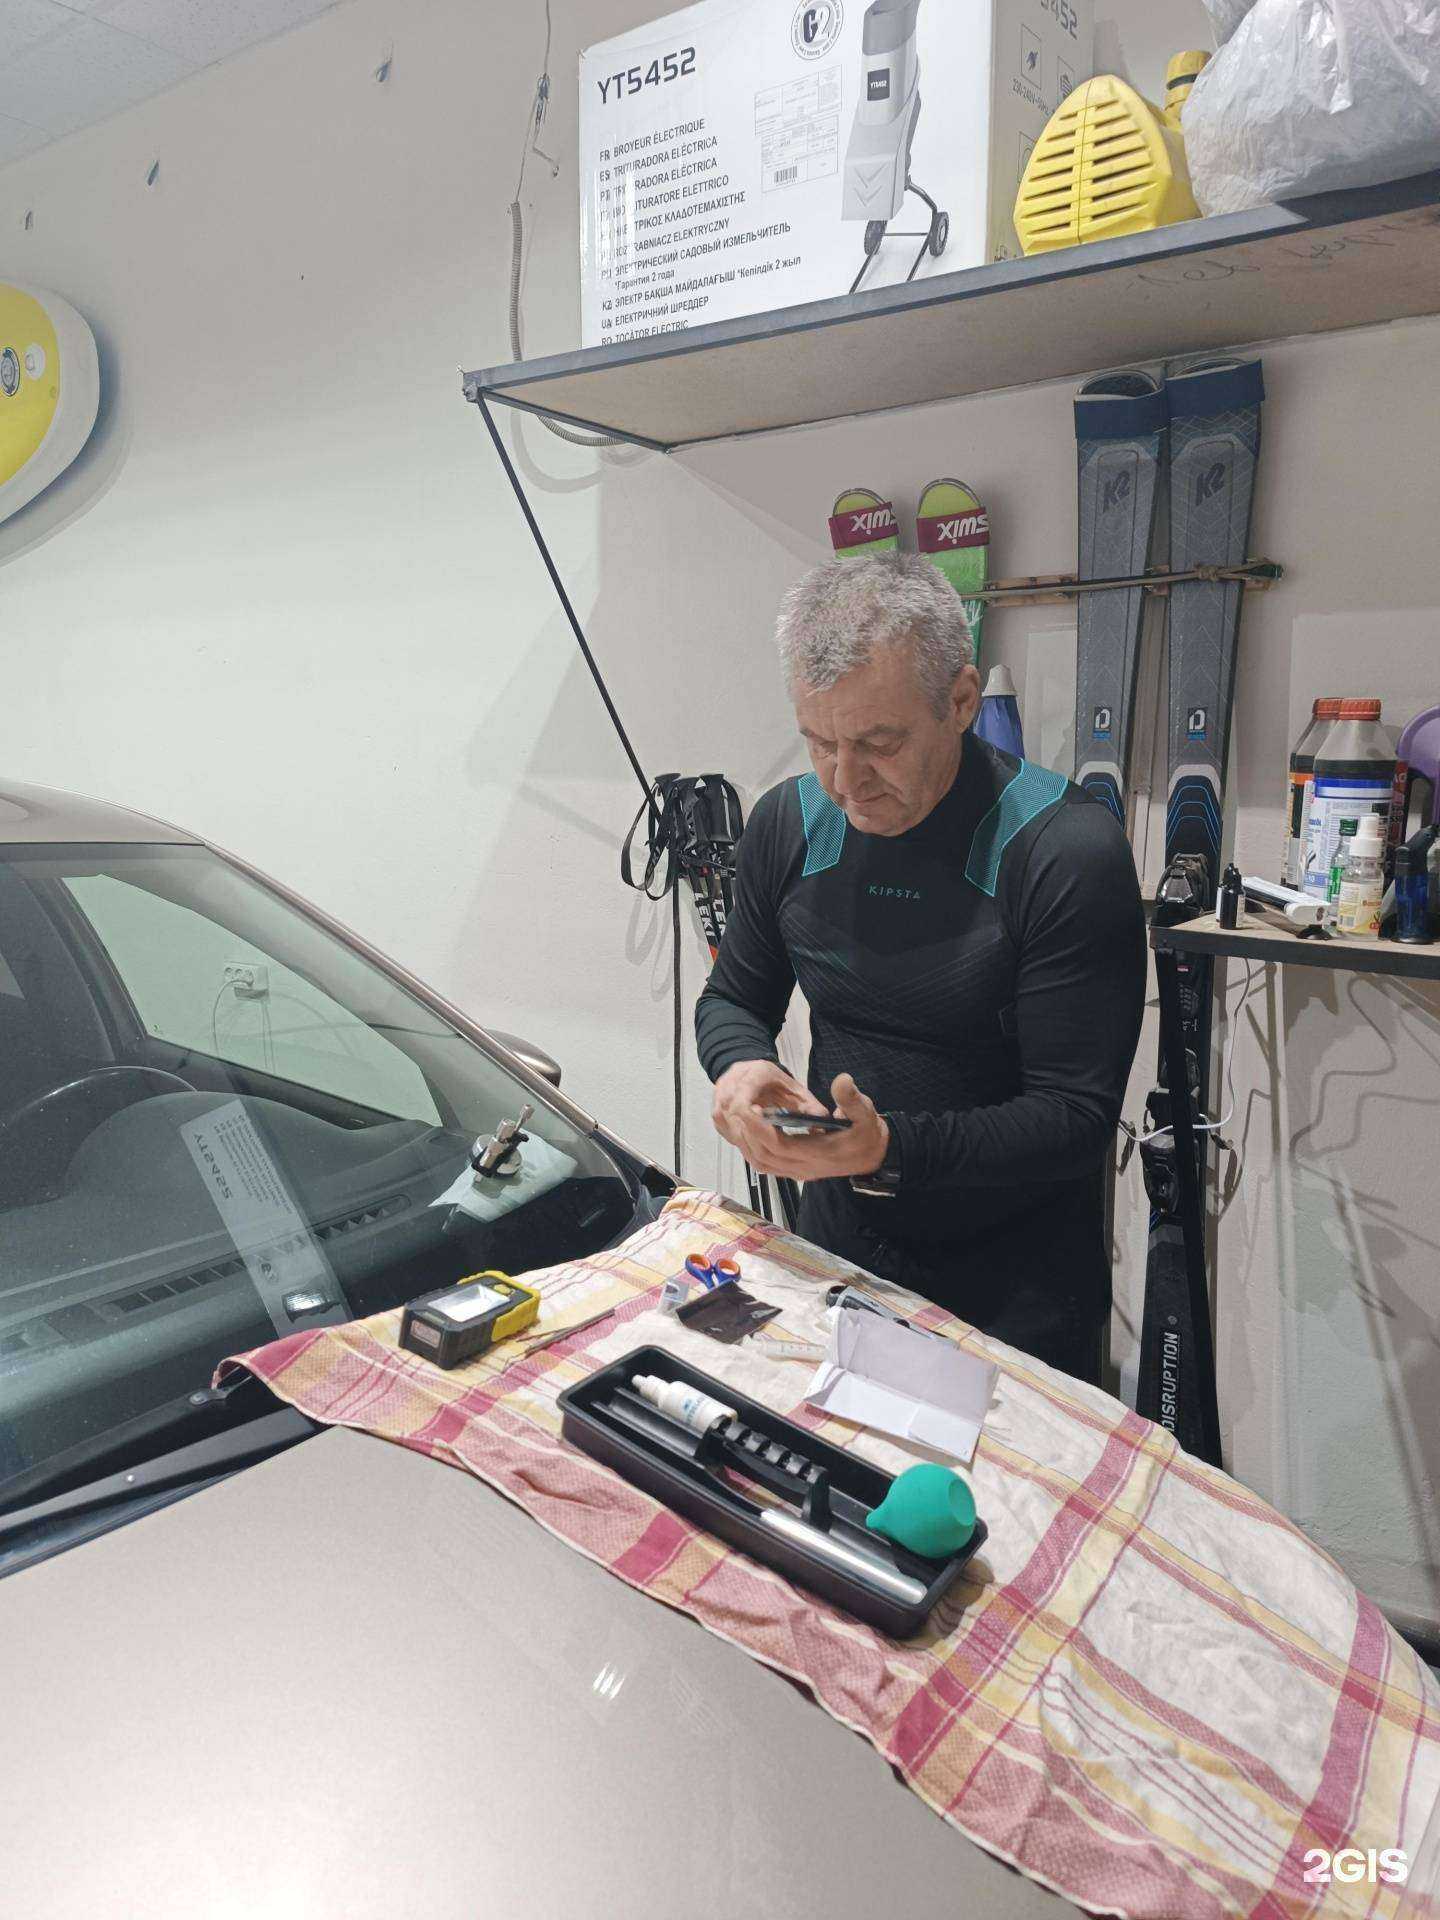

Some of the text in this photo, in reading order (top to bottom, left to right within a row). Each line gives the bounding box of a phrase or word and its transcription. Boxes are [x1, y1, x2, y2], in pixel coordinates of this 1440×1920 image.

[597, 46, 696, 104] YT5452
[600, 118, 706, 162] FR BROYEUR ÉLECTRIQUE
[600, 136, 719, 182] ES TRITURADORA ELÉCTRICA
[671, 157, 719, 182] ELÉCTRICA
[682, 174, 730, 198] ELETTRICO
[673, 219, 730, 244] ELEKTRYCZNY
[680, 237, 722, 259] САДОВЫЙ
[723, 221, 791, 249] ИЗМЕЛЬЧИТЕЛЬ
[615, 292, 643, 309] ЭЛЕКТР
[775, 258, 781, 269] 2
[782, 255, 801, 268] жыл
[651, 272, 657, 282] 2
[657, 269, 675, 280] года
[601, 296, 709, 329] UA ЕЛЕКТРИЧНИЙ ШРЕДДЕР
[1102, 470, 1131, 514] K2
[1196, 462, 1226, 507] K2
[869, 885, 921, 899] KIPSTA
[1161, 1332, 1179, 1432] DISRUPTION
